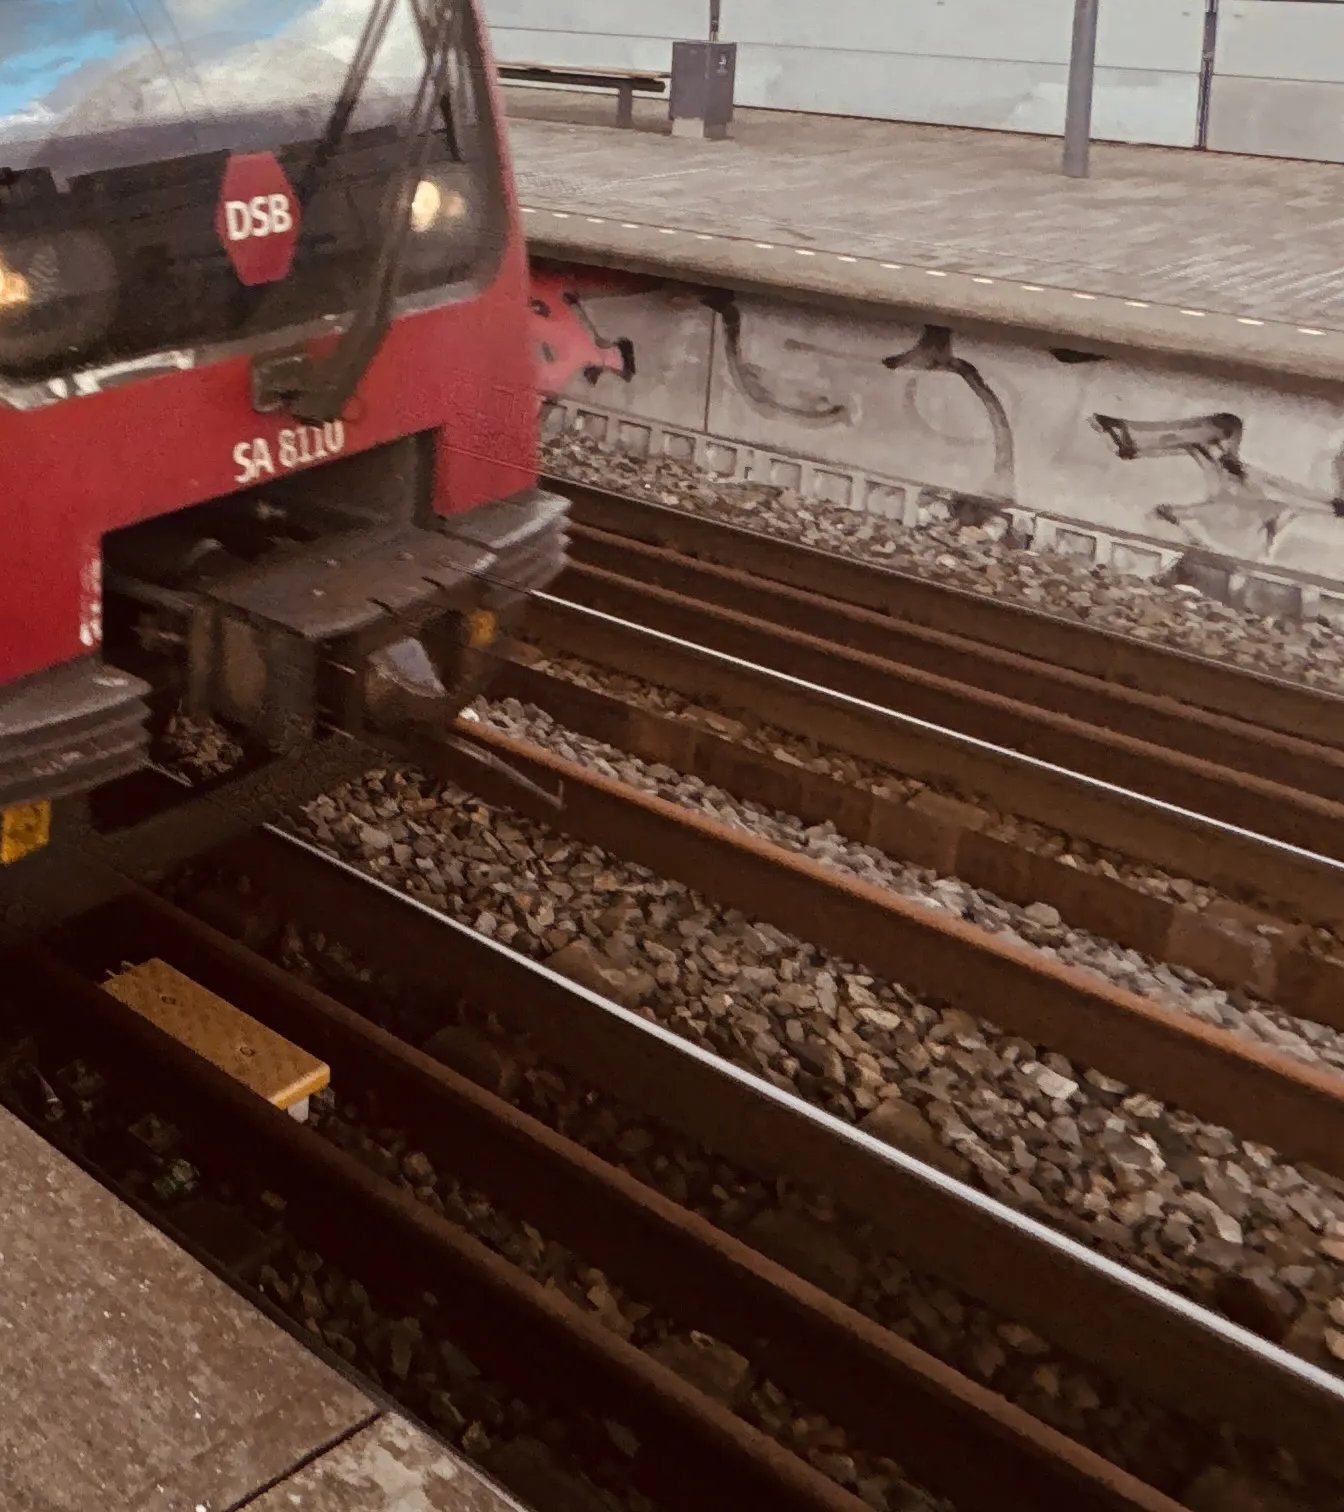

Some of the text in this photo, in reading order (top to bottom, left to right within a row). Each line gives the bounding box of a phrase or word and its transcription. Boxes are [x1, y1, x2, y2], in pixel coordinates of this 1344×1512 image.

[224, 193, 293, 241] DSB
[232, 420, 345, 483] SA 8110
